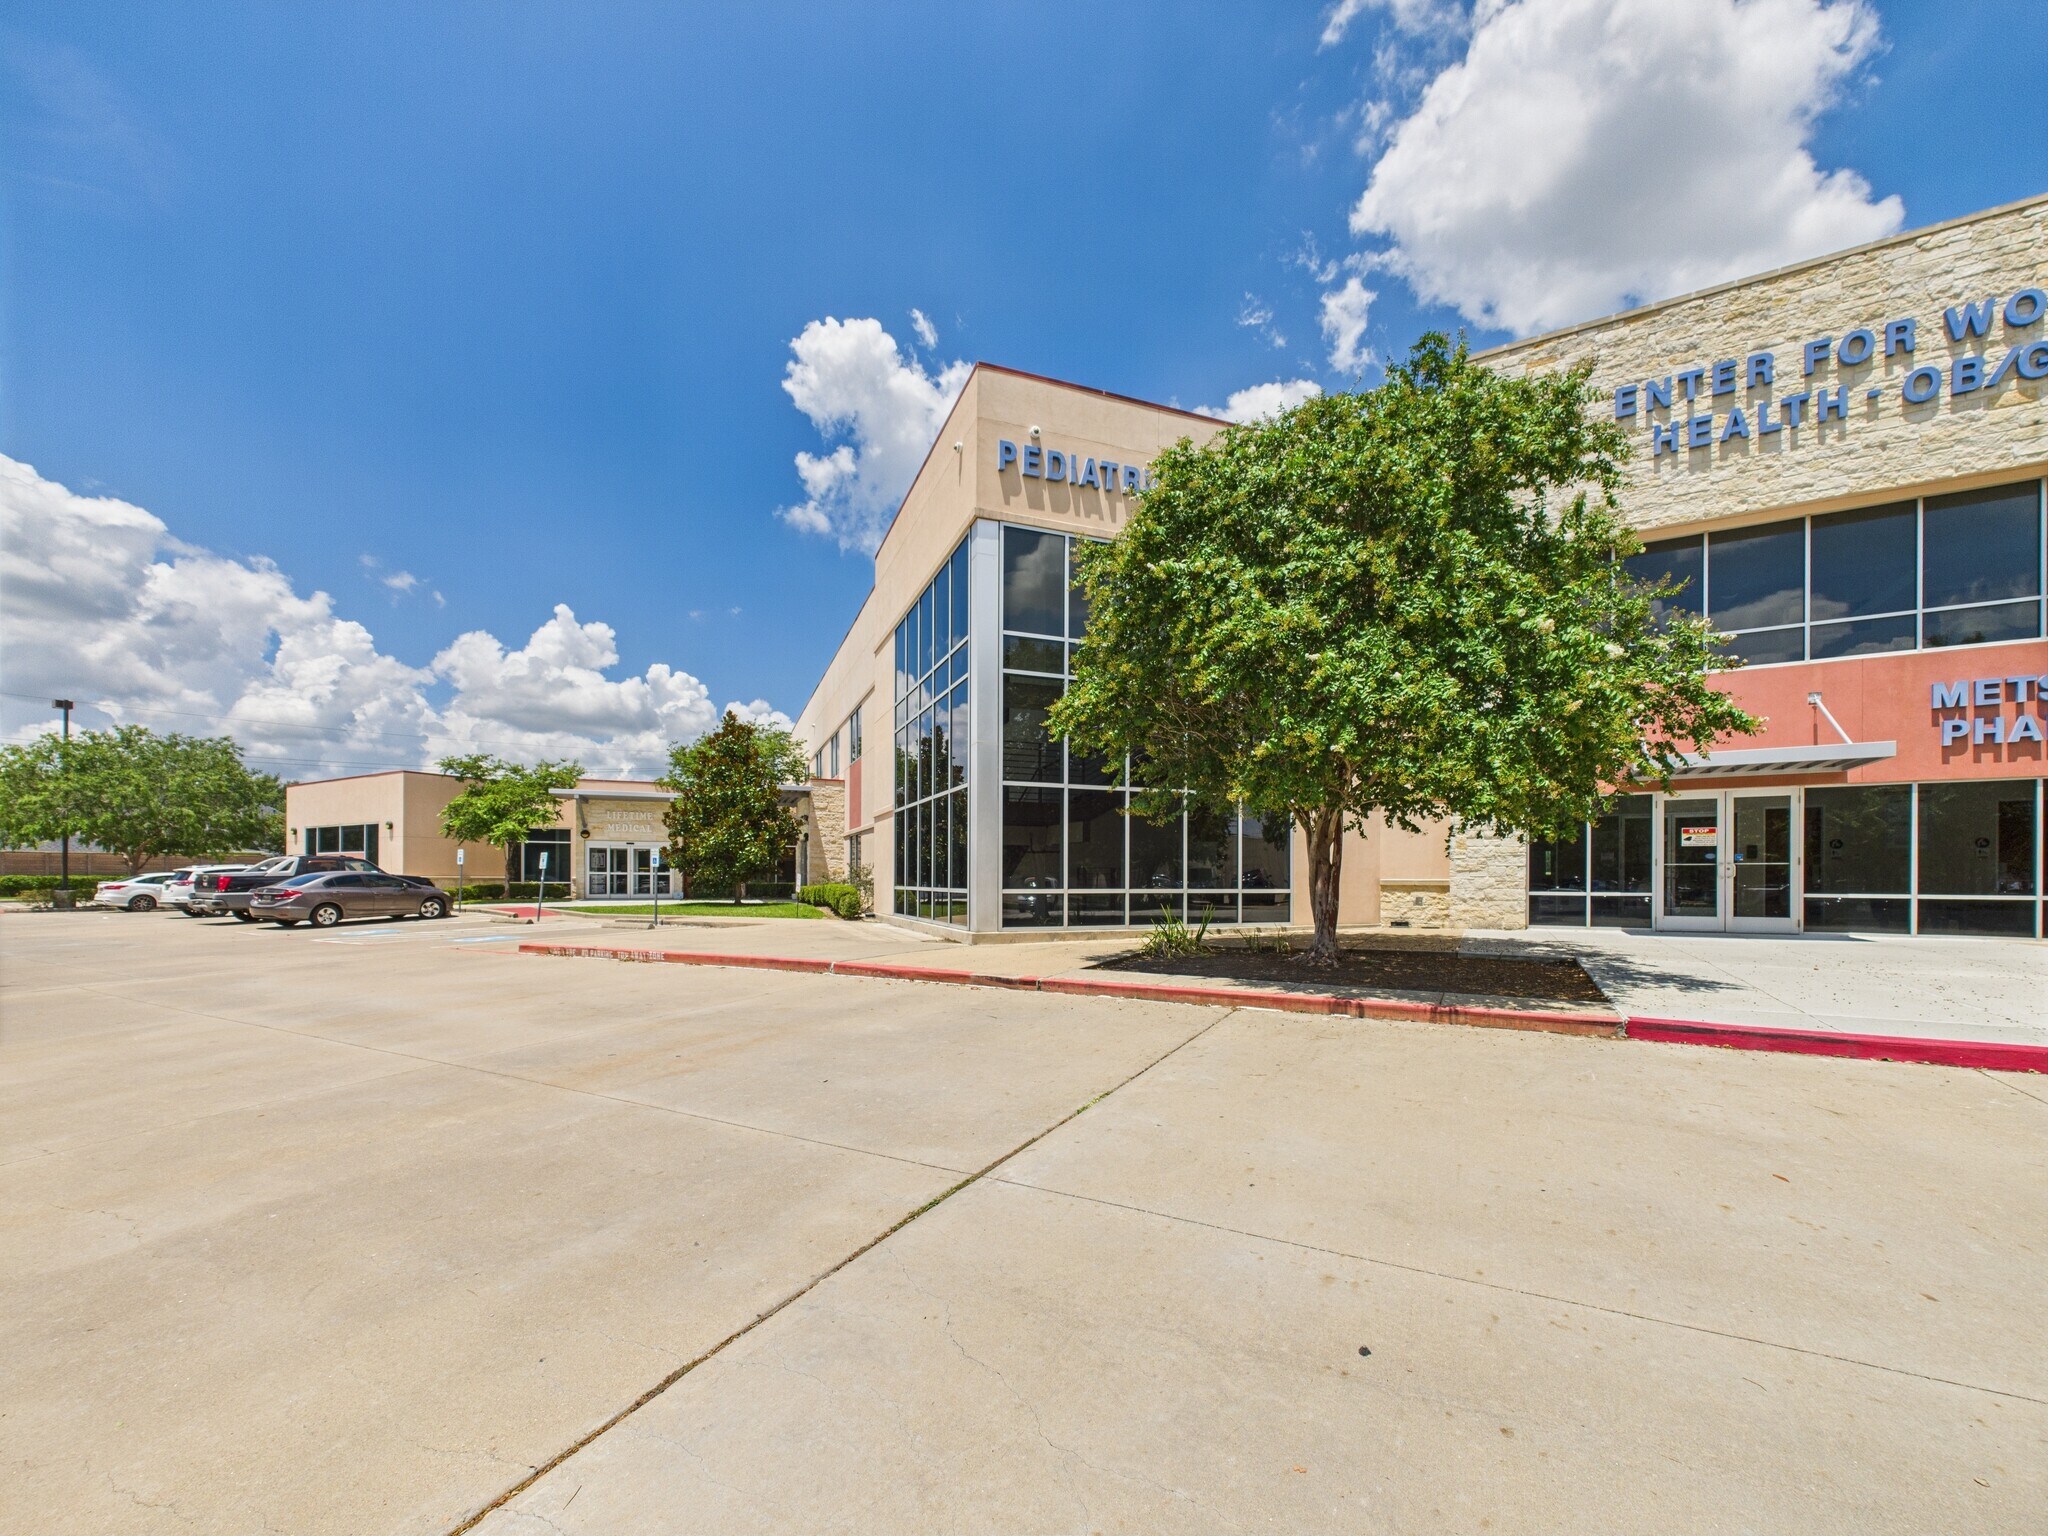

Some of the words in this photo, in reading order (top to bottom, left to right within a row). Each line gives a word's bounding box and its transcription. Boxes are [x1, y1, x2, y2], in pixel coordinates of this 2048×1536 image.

[1615, 352, 1775, 419] ENTER
[1804, 317, 1917, 376] FOR
[1943, 288, 2048, 342] WO
[1653, 384, 1849, 456] HEALTH
[998, 439, 1160, 495] PEDIATRI
[1942, 714, 2048, 746] PHA
[606, 811, 653, 820] LIFETIME
[607, 823, 652, 832] MEDICAL
